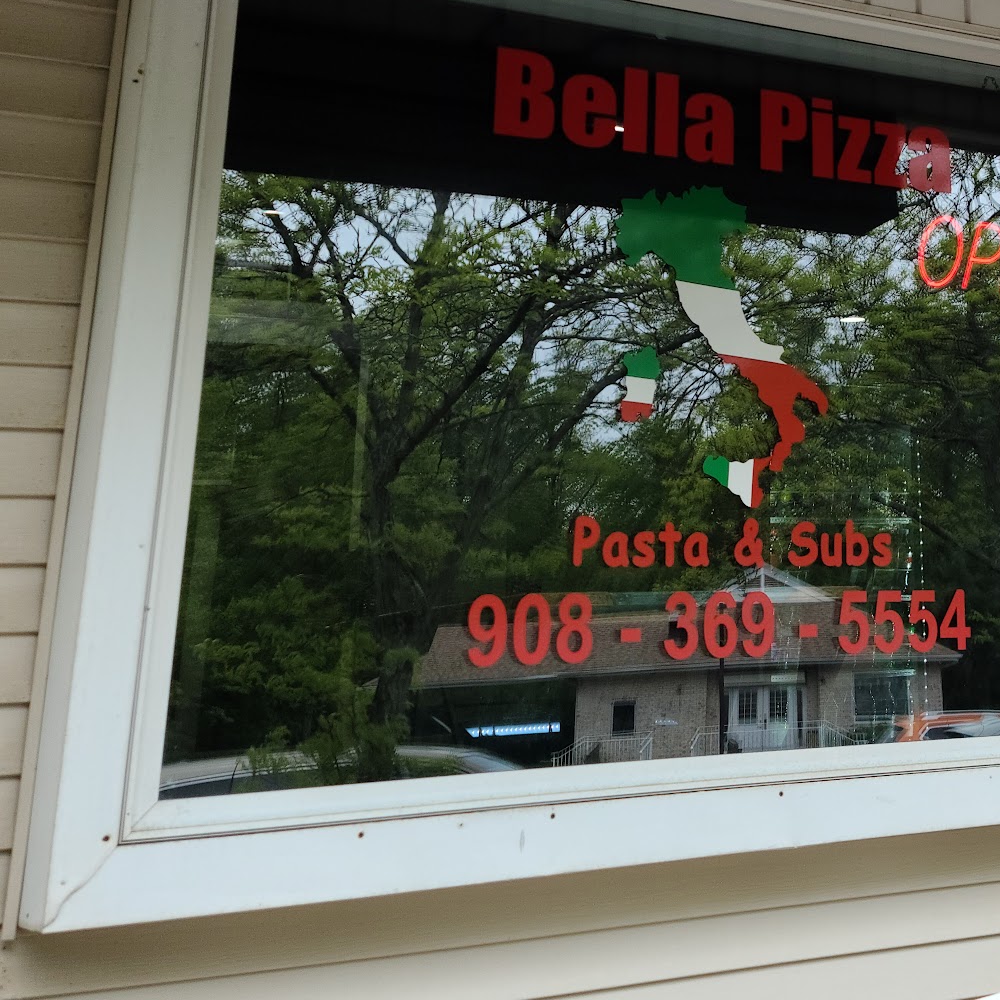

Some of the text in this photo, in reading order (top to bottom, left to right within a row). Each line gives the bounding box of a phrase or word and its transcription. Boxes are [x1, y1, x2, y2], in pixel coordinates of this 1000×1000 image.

[493, 46, 952, 194] Bella Pizza
[572, 515, 893, 568] Pasta & Subs
[467, 593, 594, 668] 908
[663, 591, 775, 660] 369
[838, 589, 972, 655] 5554
